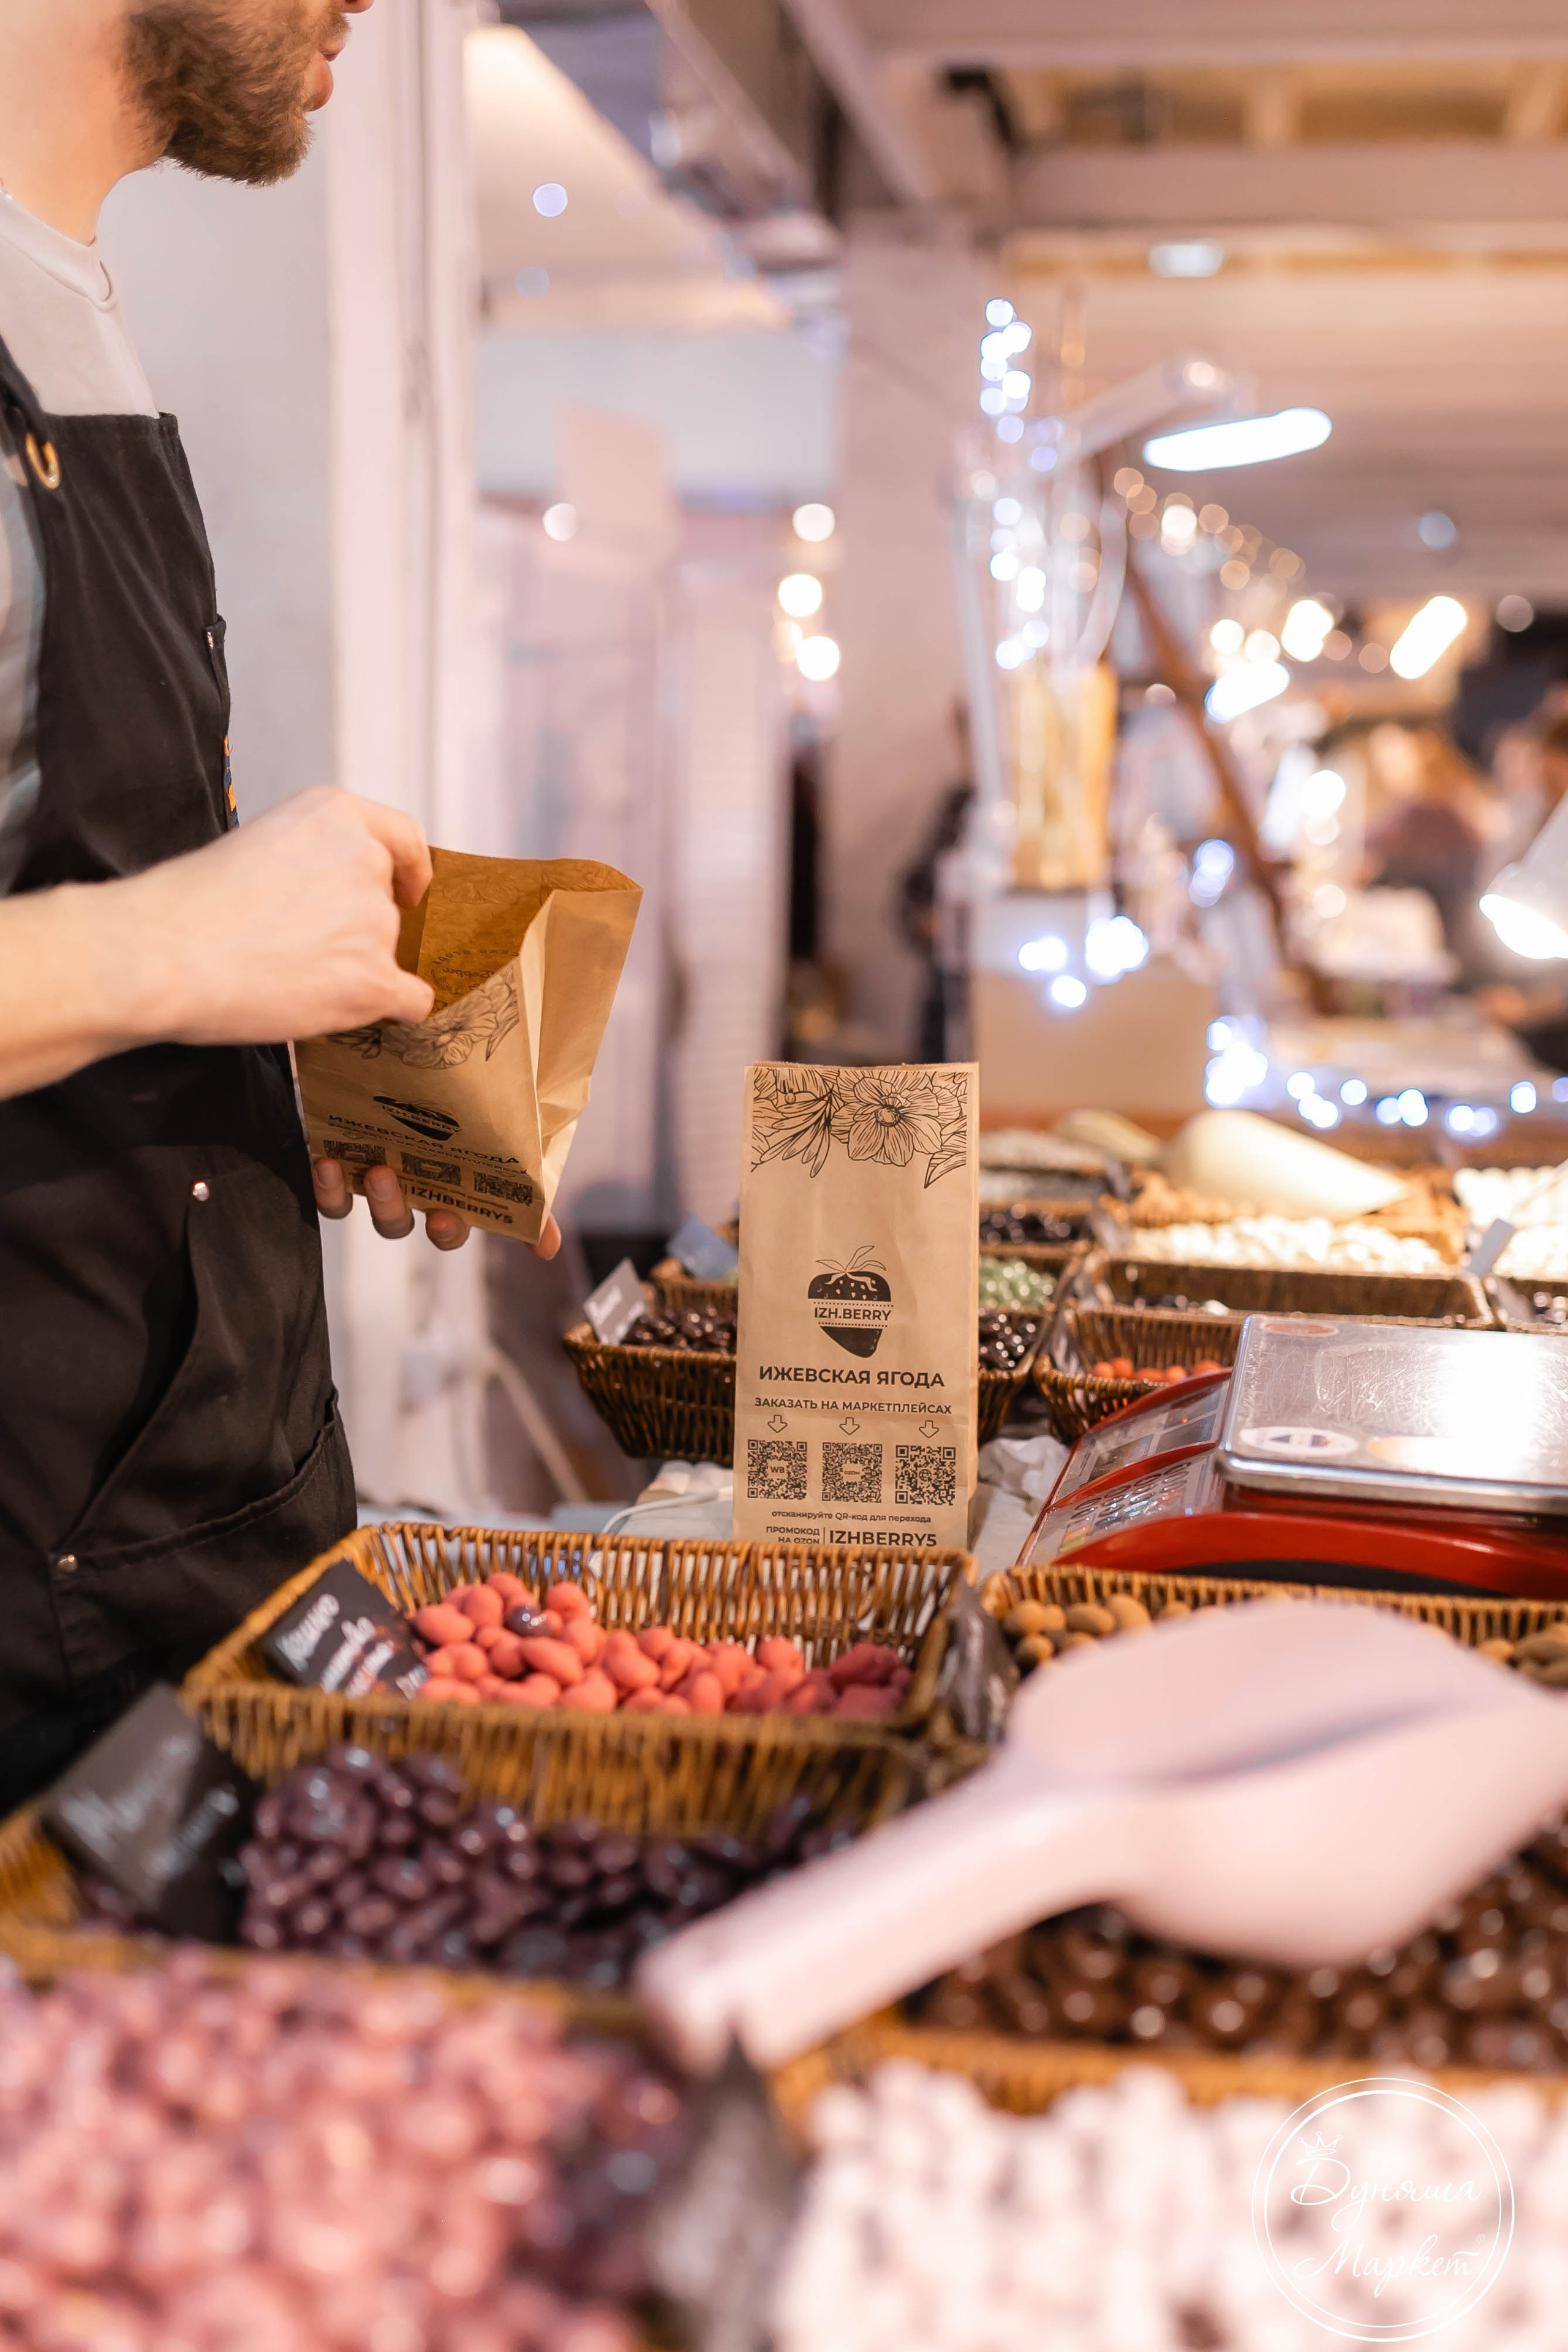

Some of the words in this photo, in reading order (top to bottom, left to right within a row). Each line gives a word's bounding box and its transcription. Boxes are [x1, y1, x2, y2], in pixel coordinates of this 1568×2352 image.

[328, 1114, 443, 1149] ИЖЕВСКАЯ
[450, 1147, 520, 1164] ЯГОДА
[411, 1185, 513, 1224] IZHBERRY5
[814, 1306, 892, 1321] IZH.BERRY
[759, 1366, 871, 1385] ИЖЕВСКАЯ
[876, 1371, 945, 1389] ЯГОДА
[754, 1397, 818, 1408] ЗАКАЗАТЬ
[821, 1401, 838, 1410] НА
[842, 1400, 952, 1415] МАРКЕТПЛЕЙСАХ
[771, 1510, 833, 1520] отсканируйте
[835, 1512, 868, 1521] QR-код
[766, 1526, 820, 1536] ПРОМОКОД
[829, 1530, 937, 1547] IZHBERRY5
